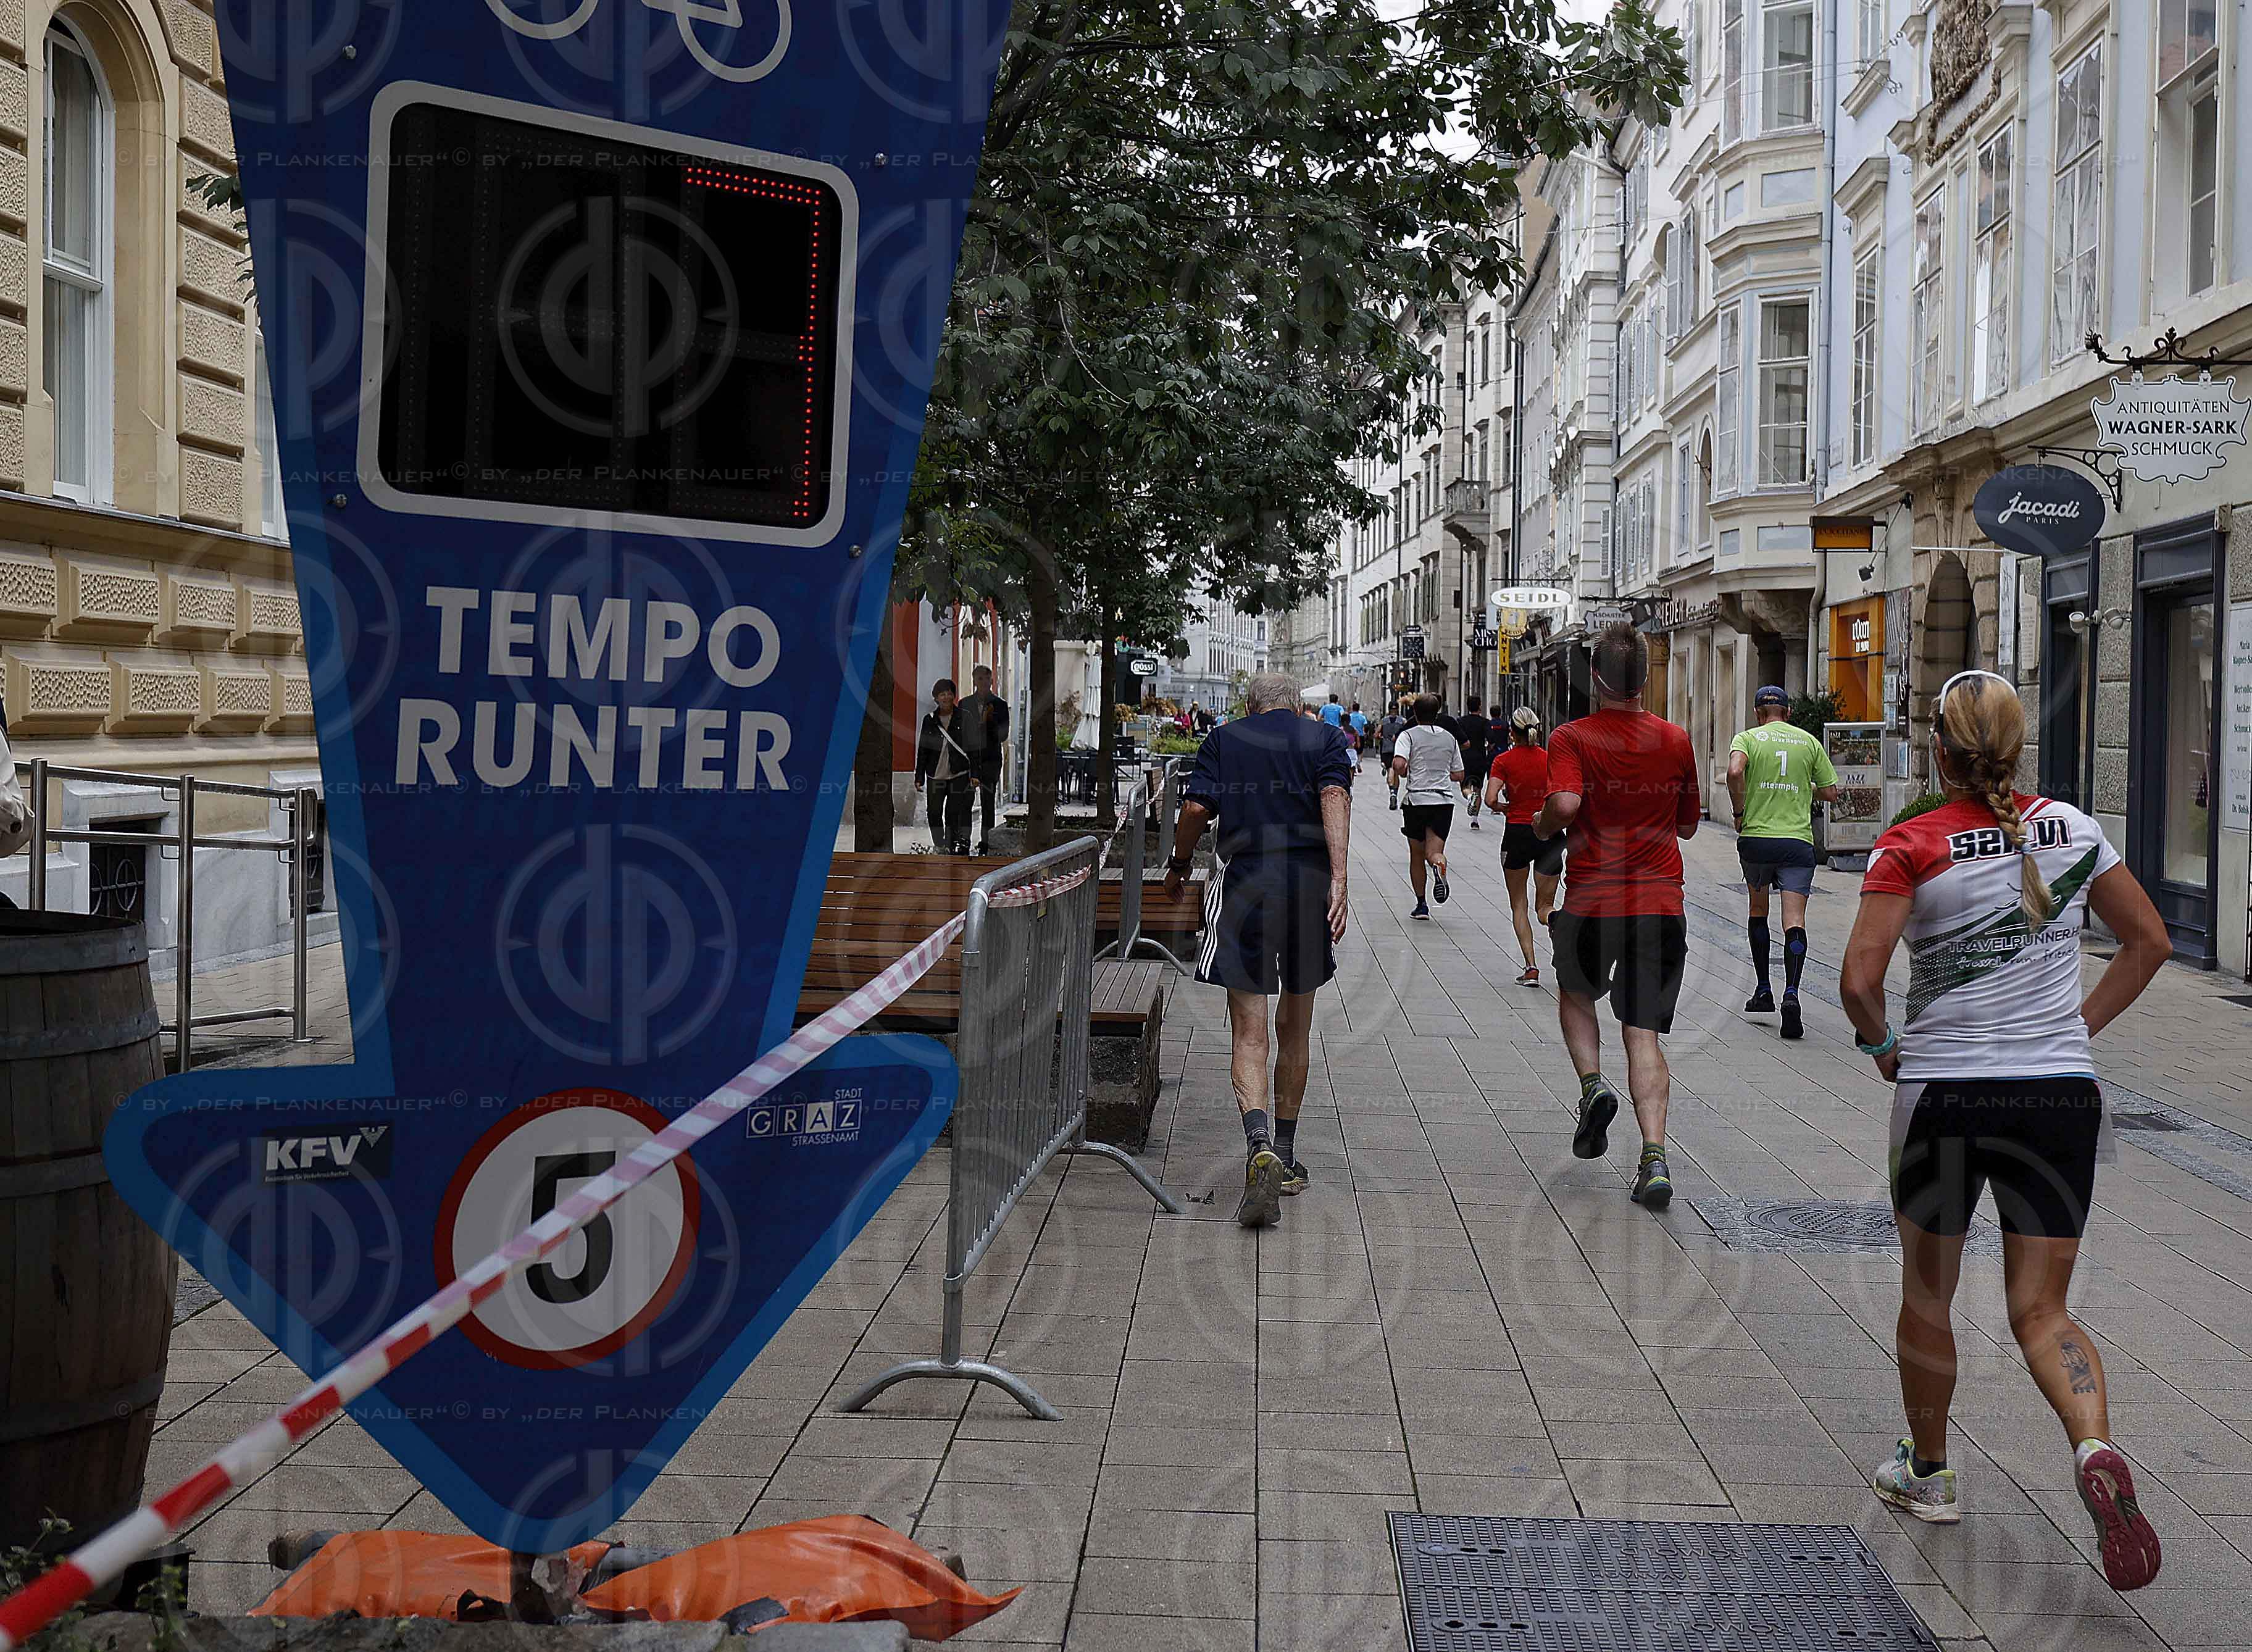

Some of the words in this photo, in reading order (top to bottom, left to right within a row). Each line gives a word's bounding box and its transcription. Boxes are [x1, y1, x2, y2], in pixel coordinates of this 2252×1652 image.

[2117, 398, 2230, 415] ANTIQUITÄTEN
[2108, 420, 2238, 435] WAGNER-SARK
[2130, 441, 2212, 457] SCHMUCK
[1997, 491, 2080, 525] jacadi
[2025, 515, 2061, 525] PARIS
[1499, 593, 1562, 603] SEIDL
[426, 586, 780, 688] TEMPO
[395, 698, 792, 790] RUNTER
[1775, 751, 1788, 777] 1
[1947, 817, 2071, 863] SZIVI
[1946, 925, 2080, 953] TRAVELRUNNER.H
[835, 1088, 862, 1099] STADT
[749, 1103, 857, 1135] GRAZ
[792, 1130, 859, 1146] STRASSENAMT
[266, 1135, 362, 1170] KFV
[525, 1151, 615, 1304] 5
